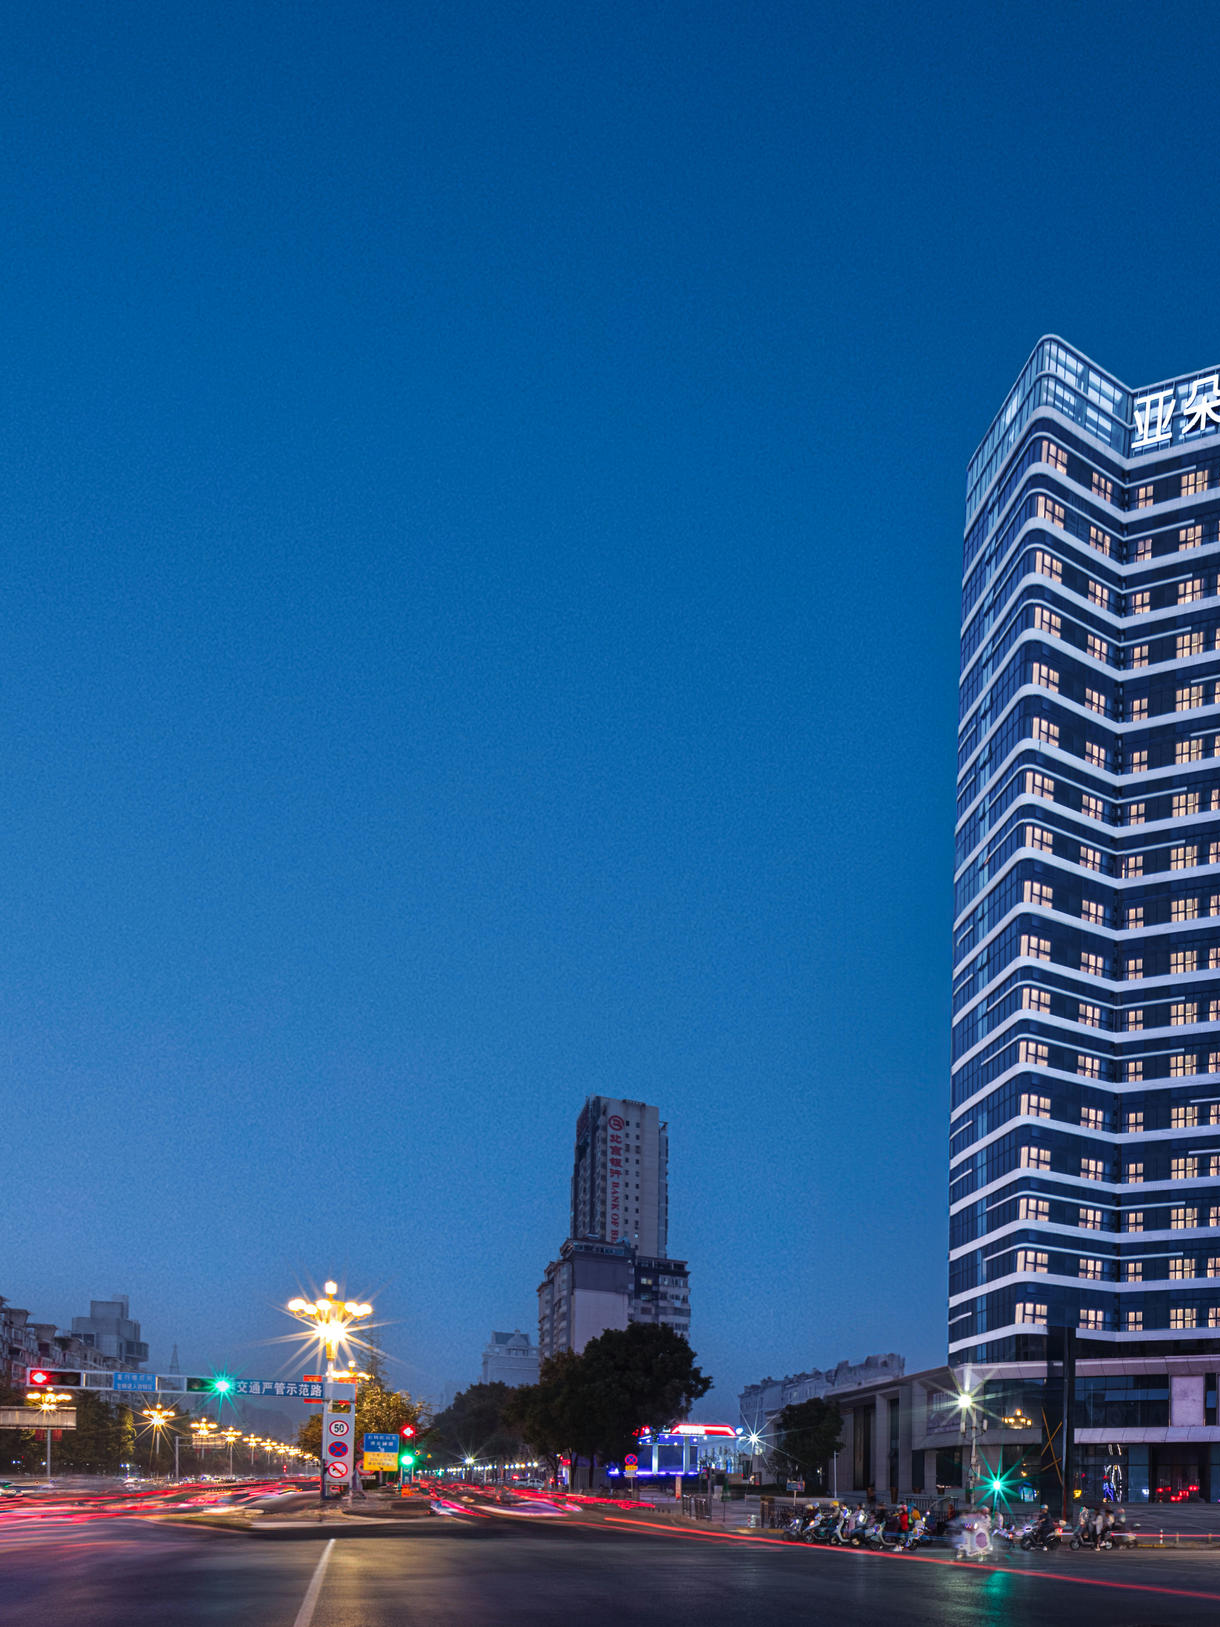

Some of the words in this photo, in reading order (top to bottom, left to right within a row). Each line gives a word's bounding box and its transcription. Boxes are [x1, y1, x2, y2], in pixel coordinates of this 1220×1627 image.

[610, 1134, 622, 1178] 北京银行
[611, 1182, 620, 1210] BANK
[611, 1213, 620, 1227] OF
[236, 1380, 322, 1397] 交通严管示范路
[334, 1423, 345, 1433] 50
